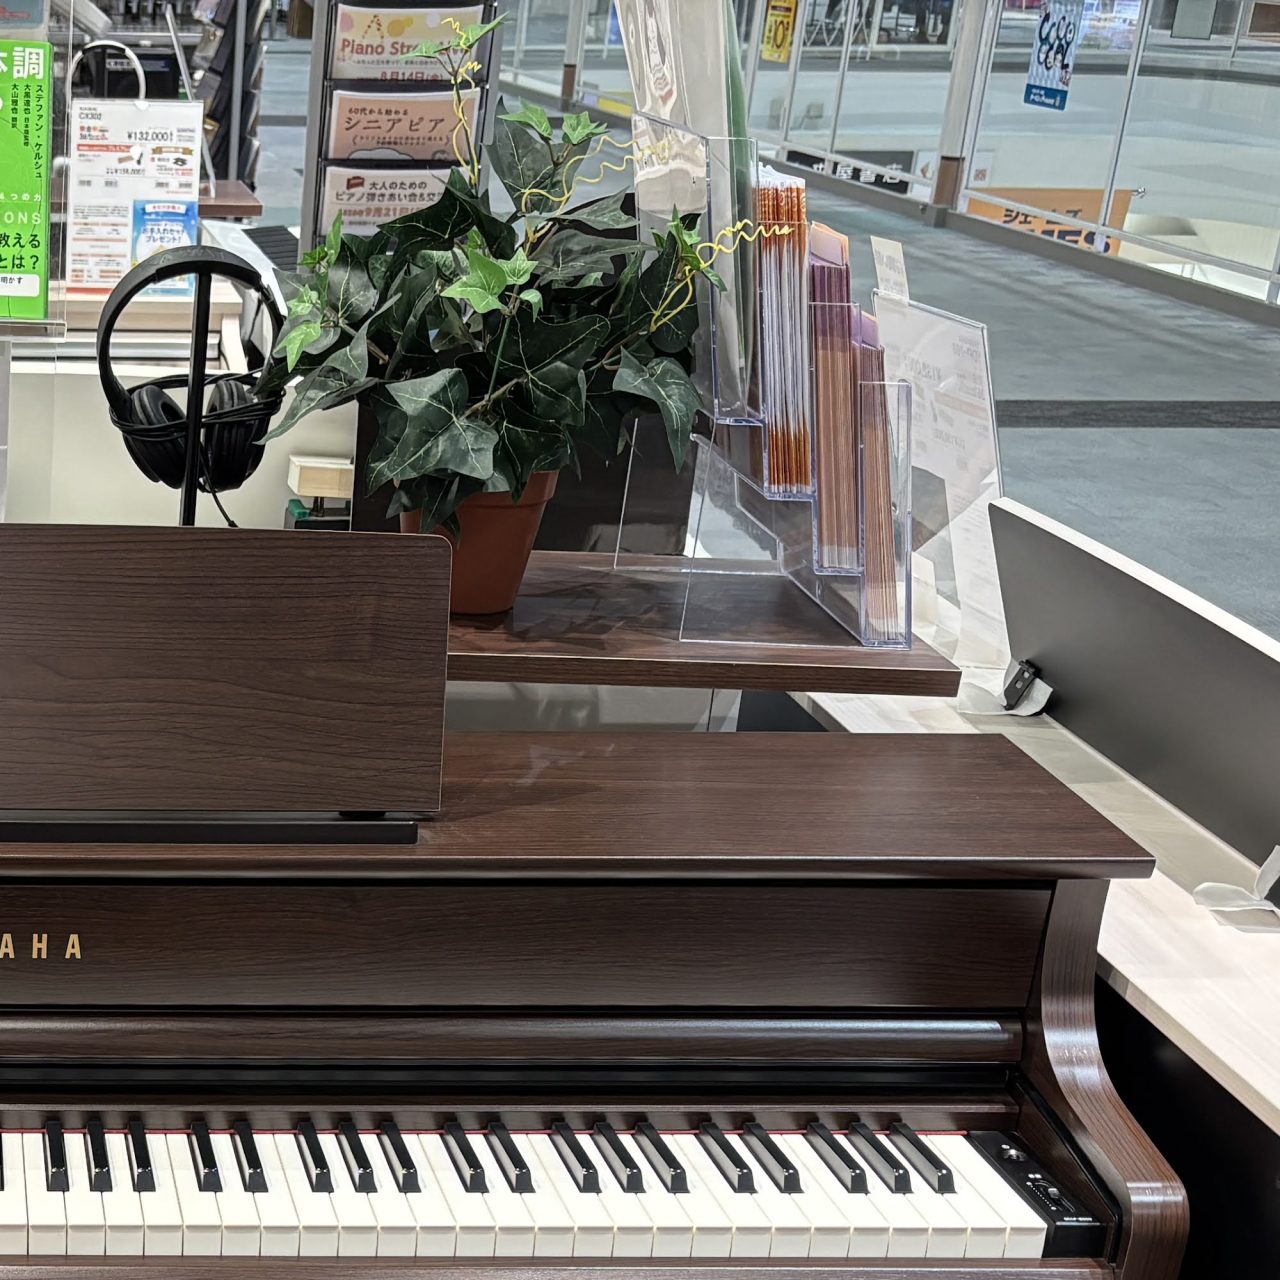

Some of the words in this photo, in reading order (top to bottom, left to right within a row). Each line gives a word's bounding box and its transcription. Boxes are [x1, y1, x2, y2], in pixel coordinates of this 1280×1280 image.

[341, 38, 385, 55] Piano
[34, 84, 45, 178] ステファン・ケルシュ
[369, 181, 427, 190] 大人のための
[335, 192, 443, 202] ピアノ弾きあい会&交
